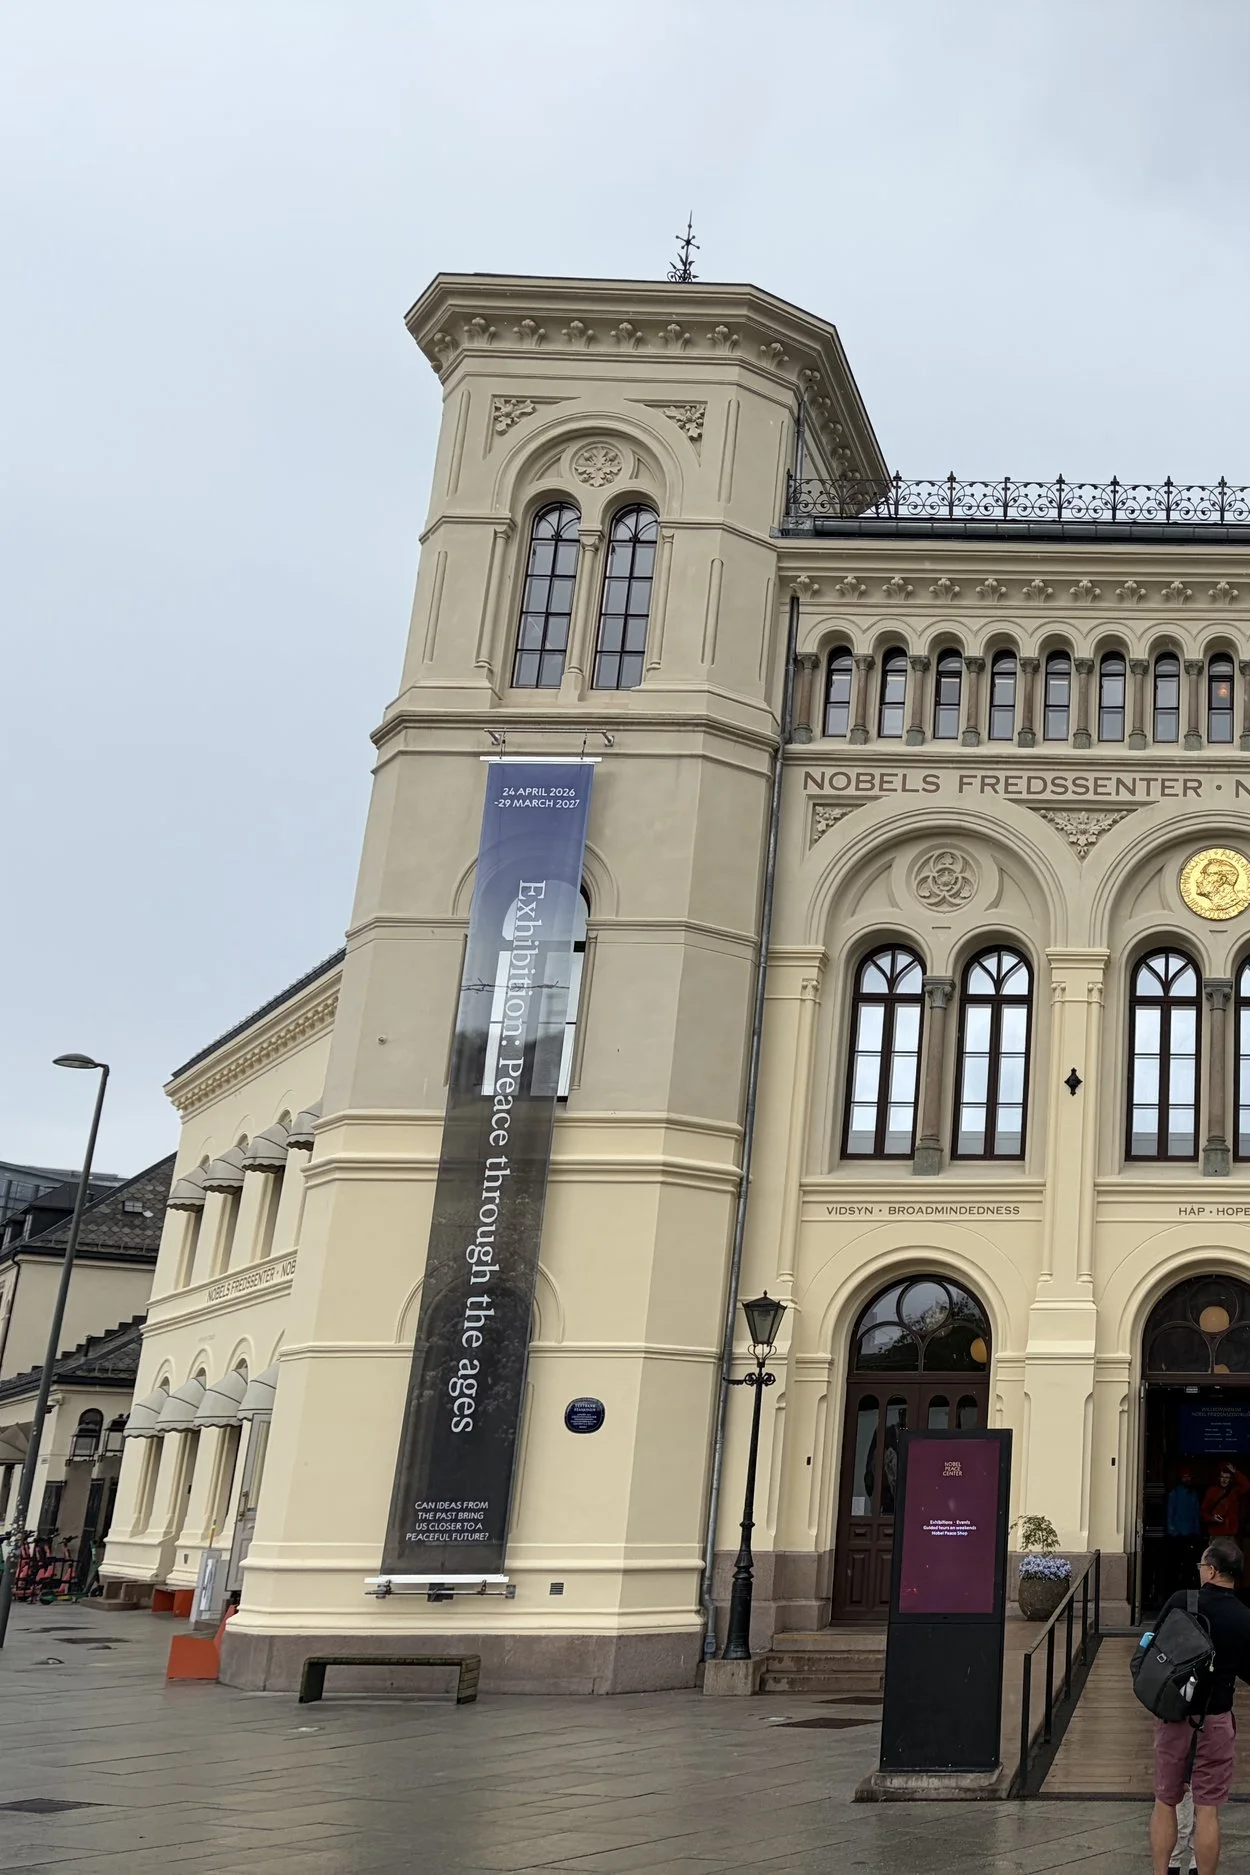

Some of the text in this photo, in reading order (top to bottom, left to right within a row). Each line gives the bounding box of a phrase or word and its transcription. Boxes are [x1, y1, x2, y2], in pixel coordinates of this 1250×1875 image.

[803, 770, 941, 794] NOBELS
[958, 774, 1203, 798] FREDSSENTER
[502, 787, 576, 797] 24 APRIL 2026
[494, 799, 580, 808] -29 MARCH 2027
[448, 879, 546, 1433] Exhibition: Peace through the ages
[826, 1206, 1020, 1215] VIDSYN BROADMINDEDNESS
[280, 1259, 297, 1278] NOB
[414, 1501, 489, 1509] CAN IDEAS FROM
[417, 1512, 484, 1520] THE PAST BRING
[415, 1522, 483, 1530] US CLOSER TO A
[405, 1533, 489, 1541] PEACEFUL FUTURE?
